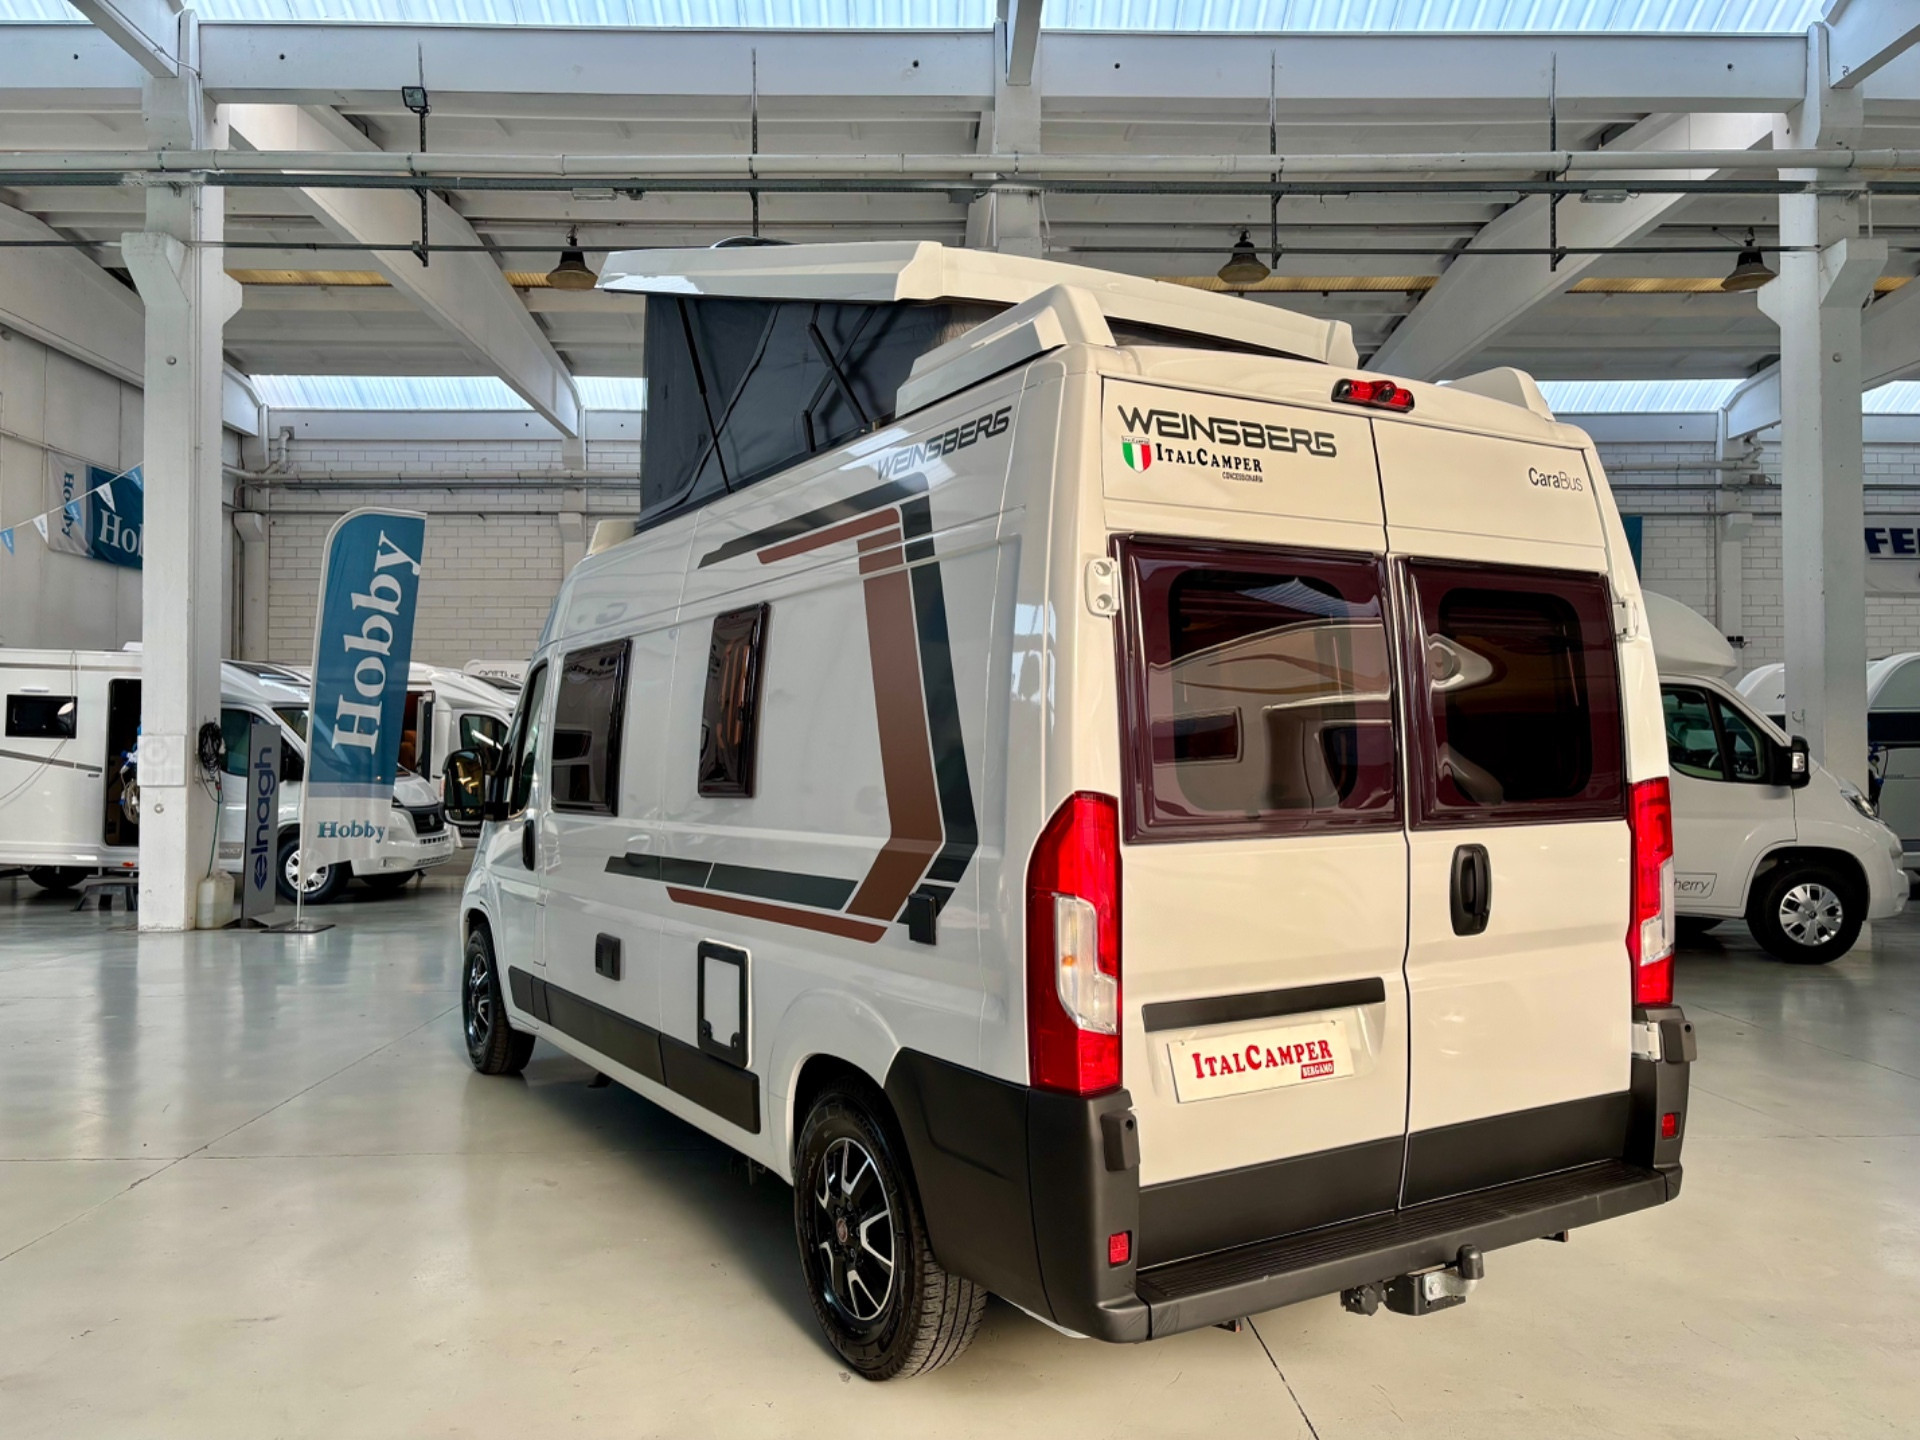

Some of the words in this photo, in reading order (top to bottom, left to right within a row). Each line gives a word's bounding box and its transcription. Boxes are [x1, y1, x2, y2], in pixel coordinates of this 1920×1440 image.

[877, 405, 1012, 481] WEINSBERG
[1117, 404, 1337, 458] WEINSBERG
[1528, 467, 1583, 492] CaraBus
[1864, 527, 1920, 554] FE
[331, 530, 421, 755] Hobby
[250, 747, 276, 891] elnagh
[317, 819, 385, 844] Hobby
[1674, 878, 1710, 894] herry
[1302, 1062, 1334, 1078] BERGAMO
